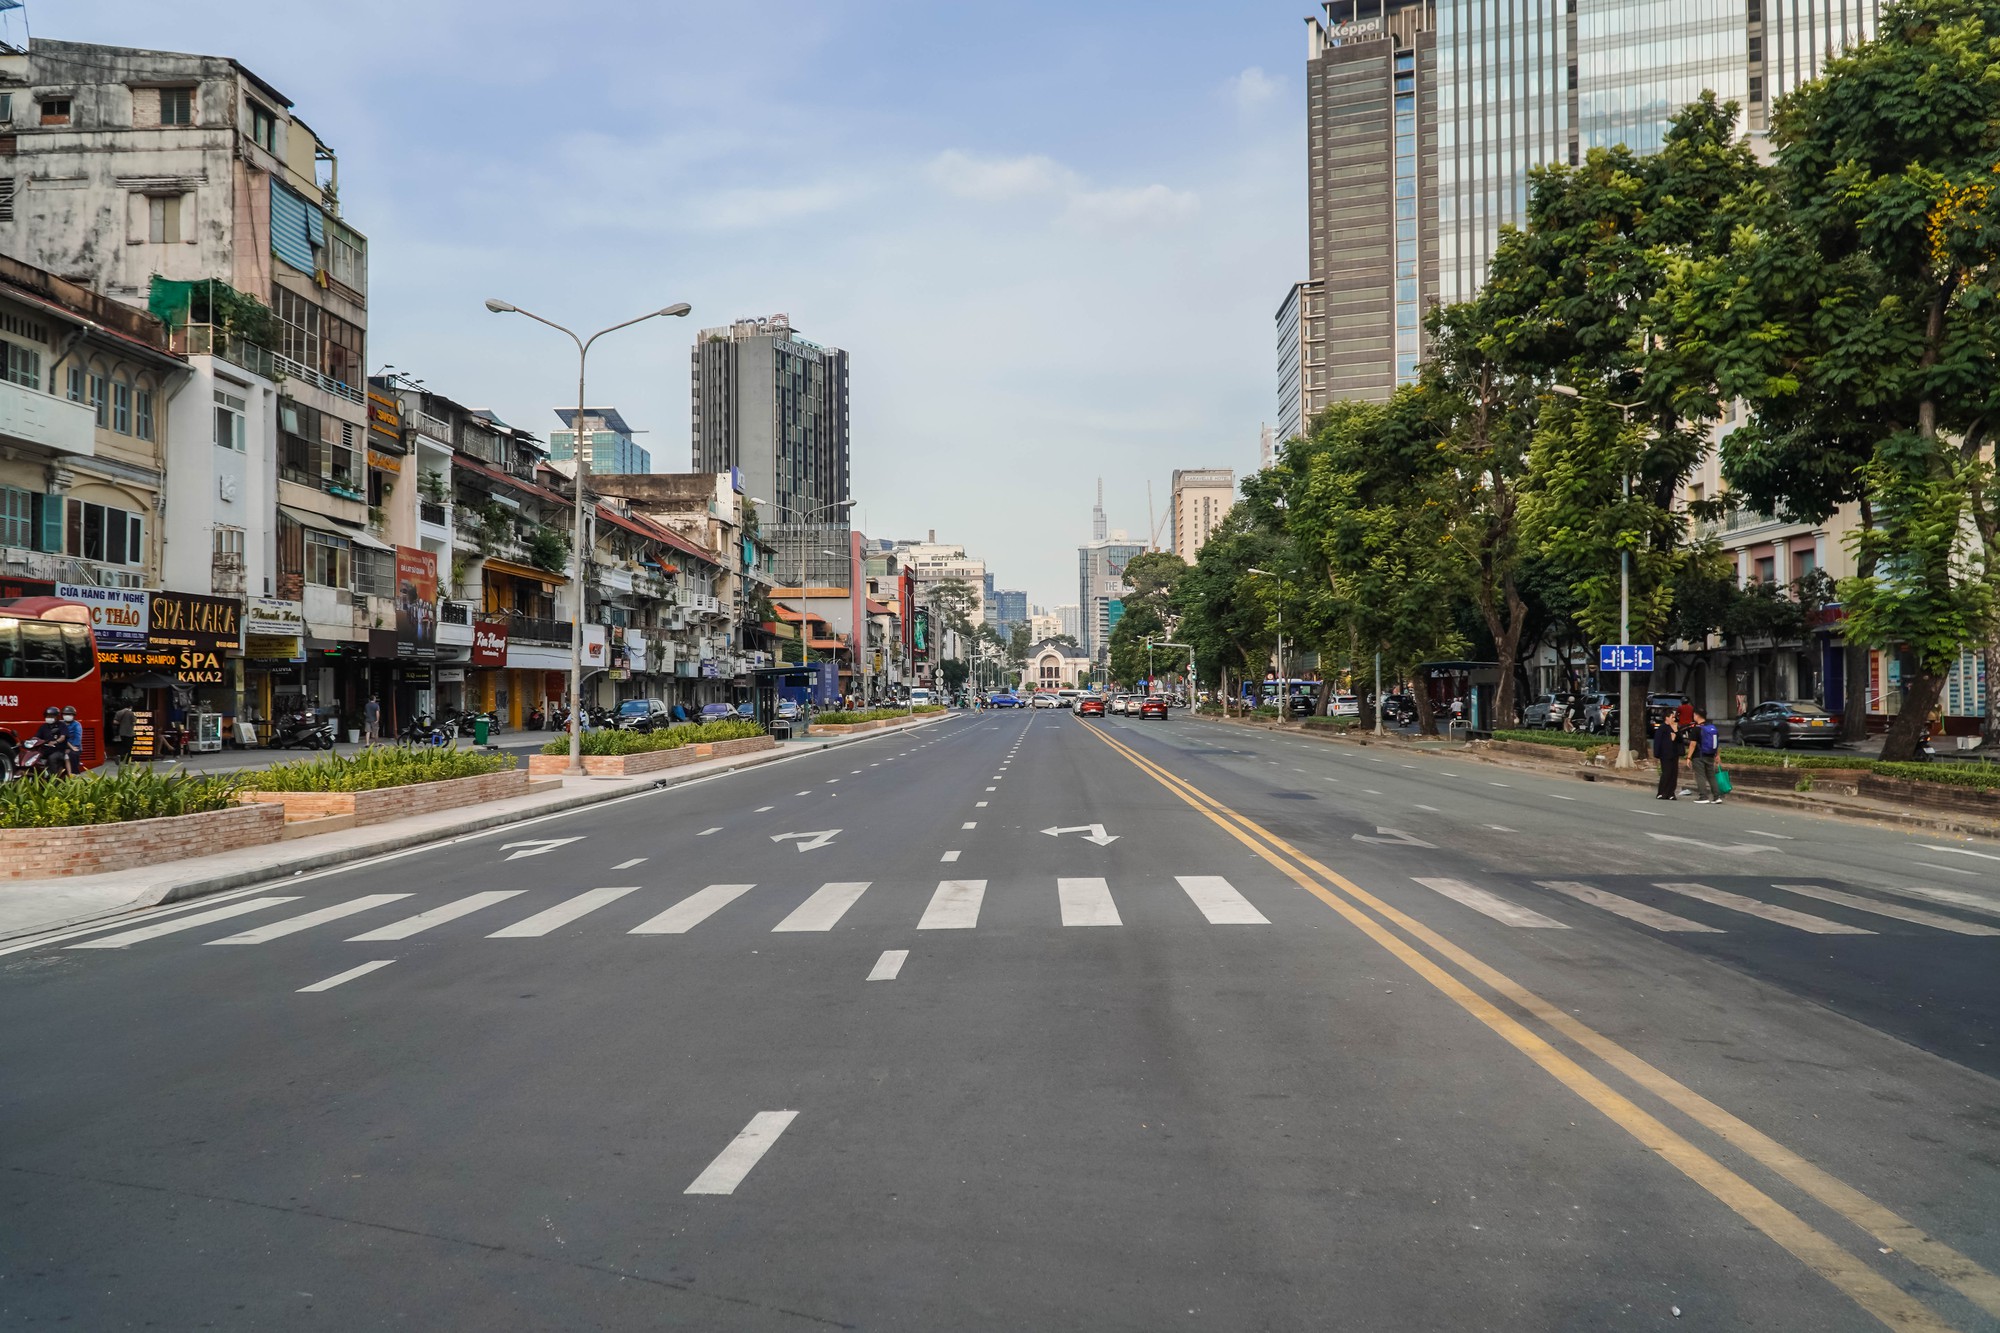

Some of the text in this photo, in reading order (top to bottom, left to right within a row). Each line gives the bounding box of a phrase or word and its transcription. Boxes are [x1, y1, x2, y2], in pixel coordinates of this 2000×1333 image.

[1331, 19, 1379, 37] Keppel
[60, 584, 145, 605] CỬA HÀNG MỸ NGHỆ
[104, 604, 140, 627] THẢO
[152, 598, 184, 630] SPA
[190, 601, 238, 634] KAKA
[97, 652, 176, 665] SSAGE NAILS SHAMPOO
[180, 652, 220, 668] SPA
[178, 672, 222, 682] KAKA2
